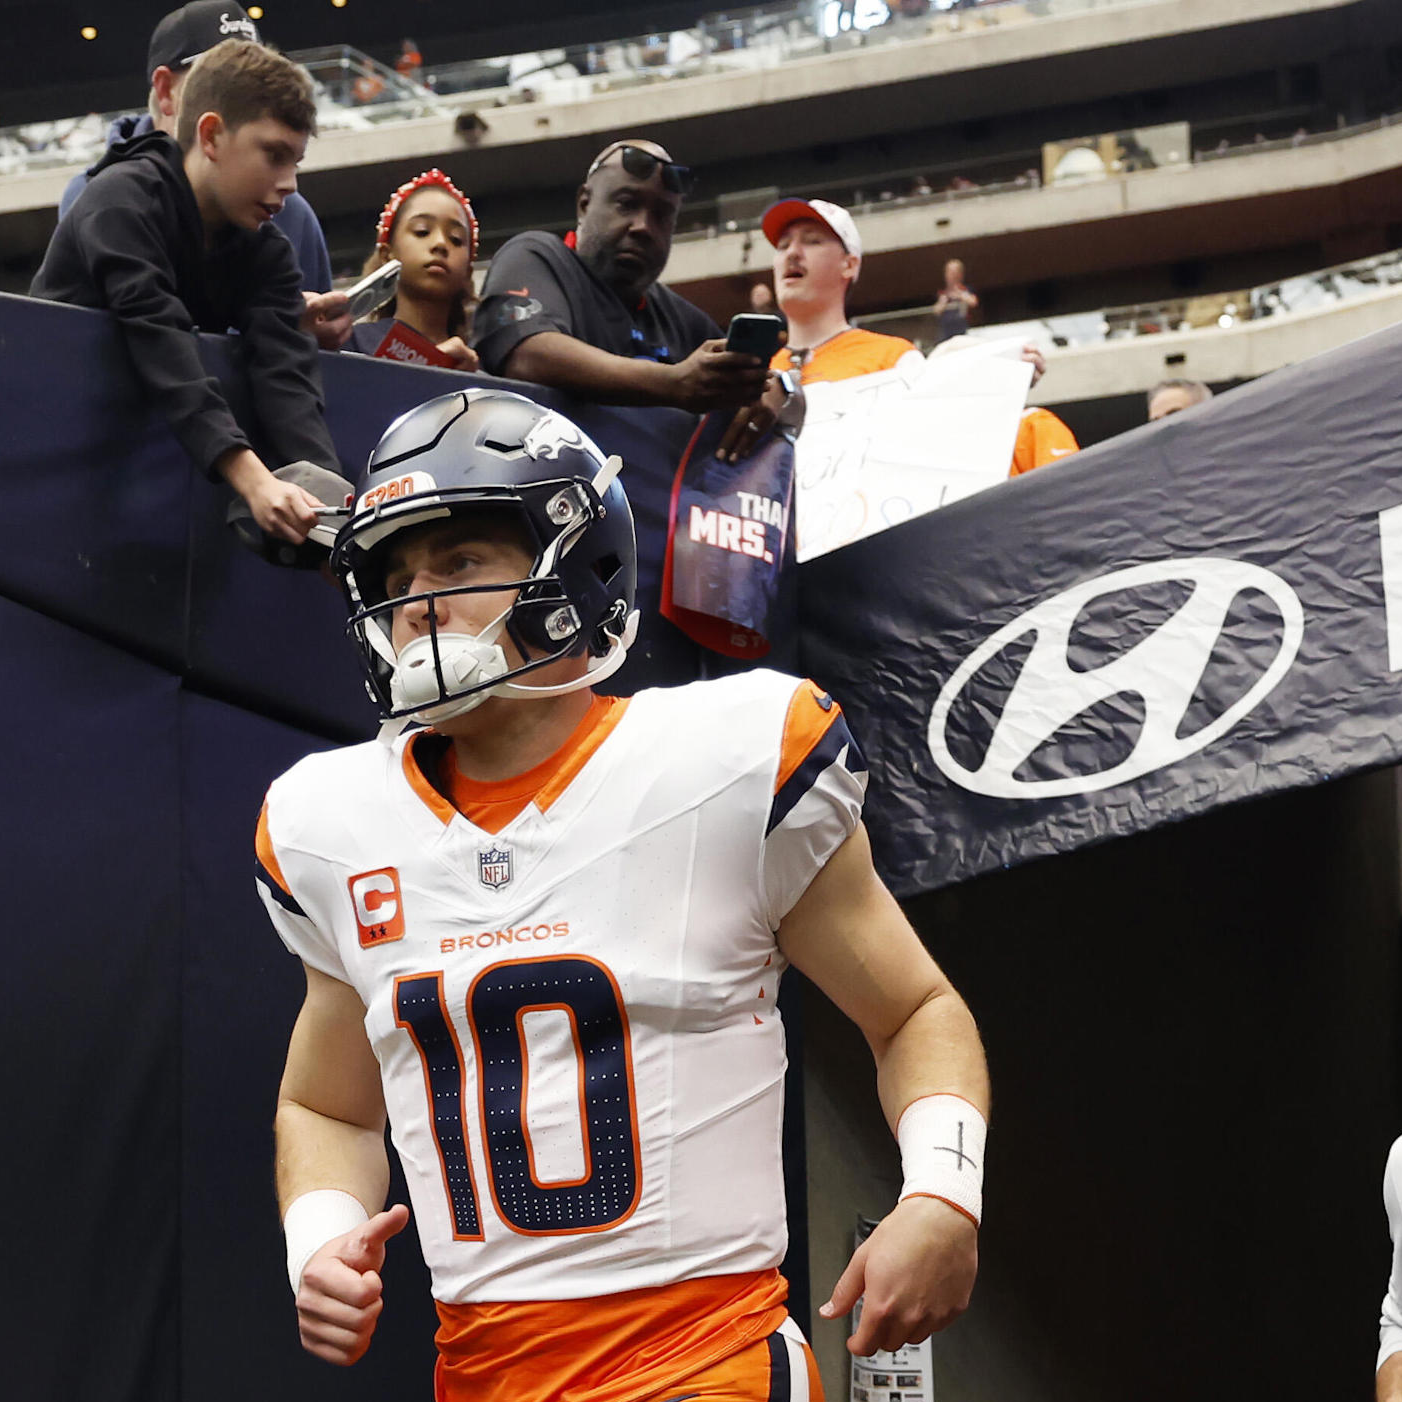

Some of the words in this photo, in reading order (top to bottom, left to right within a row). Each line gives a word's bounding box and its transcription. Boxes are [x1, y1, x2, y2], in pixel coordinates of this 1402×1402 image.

[689, 505, 775, 565] MRS.
[352, 873, 398, 928] C
[483, 866, 508, 883] NFL
[440, 922, 570, 953] BRONCOS
[392, 954, 643, 1242] 10
